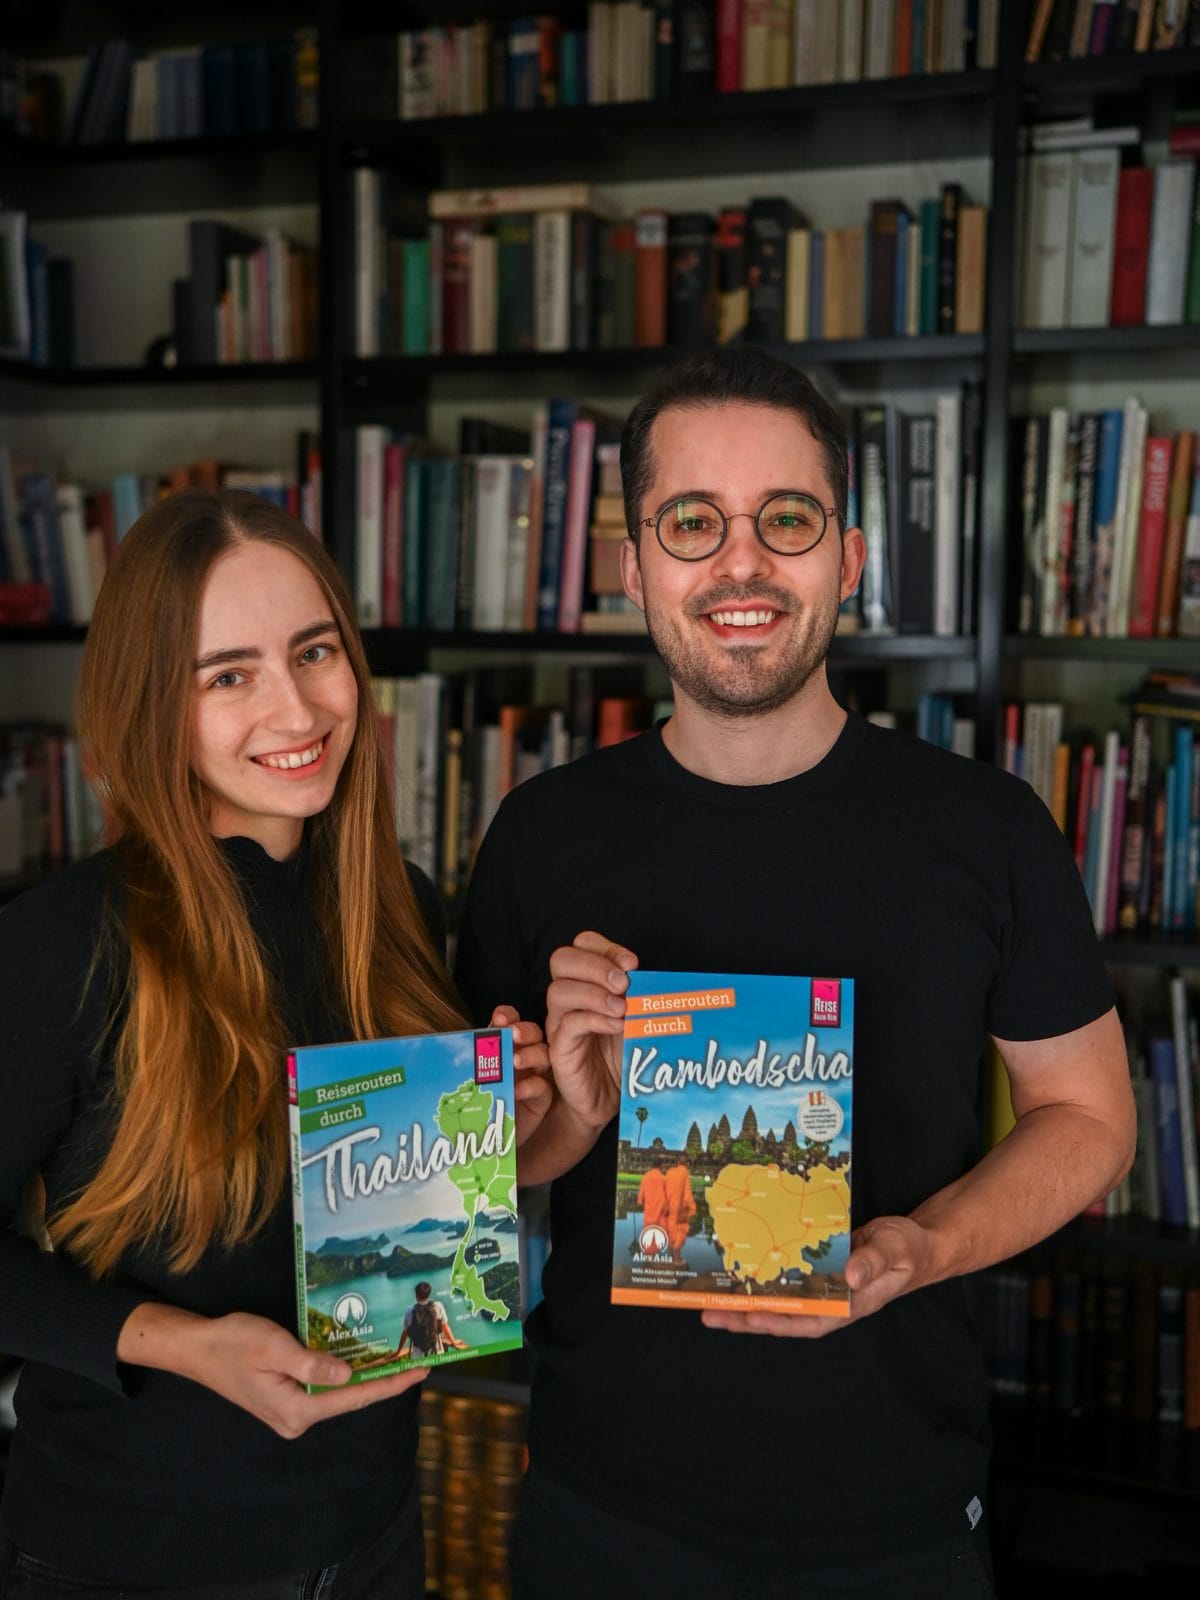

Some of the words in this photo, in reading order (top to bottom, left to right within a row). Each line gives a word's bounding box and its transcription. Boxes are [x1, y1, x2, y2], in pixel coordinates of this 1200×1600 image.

[642, 993, 730, 1011] Reiserouten
[814, 997, 837, 1013] REISE
[643, 1017, 688, 1035] durch
[478, 1055, 499, 1070] REISE
[628, 1032, 852, 1099] Kambodscha
[315, 1071, 403, 1104] Reiserouten
[319, 1106, 363, 1127] durch
[301, 1099, 515, 1214] Thailand
[327, 1323, 374, 1342] AlexAsia
